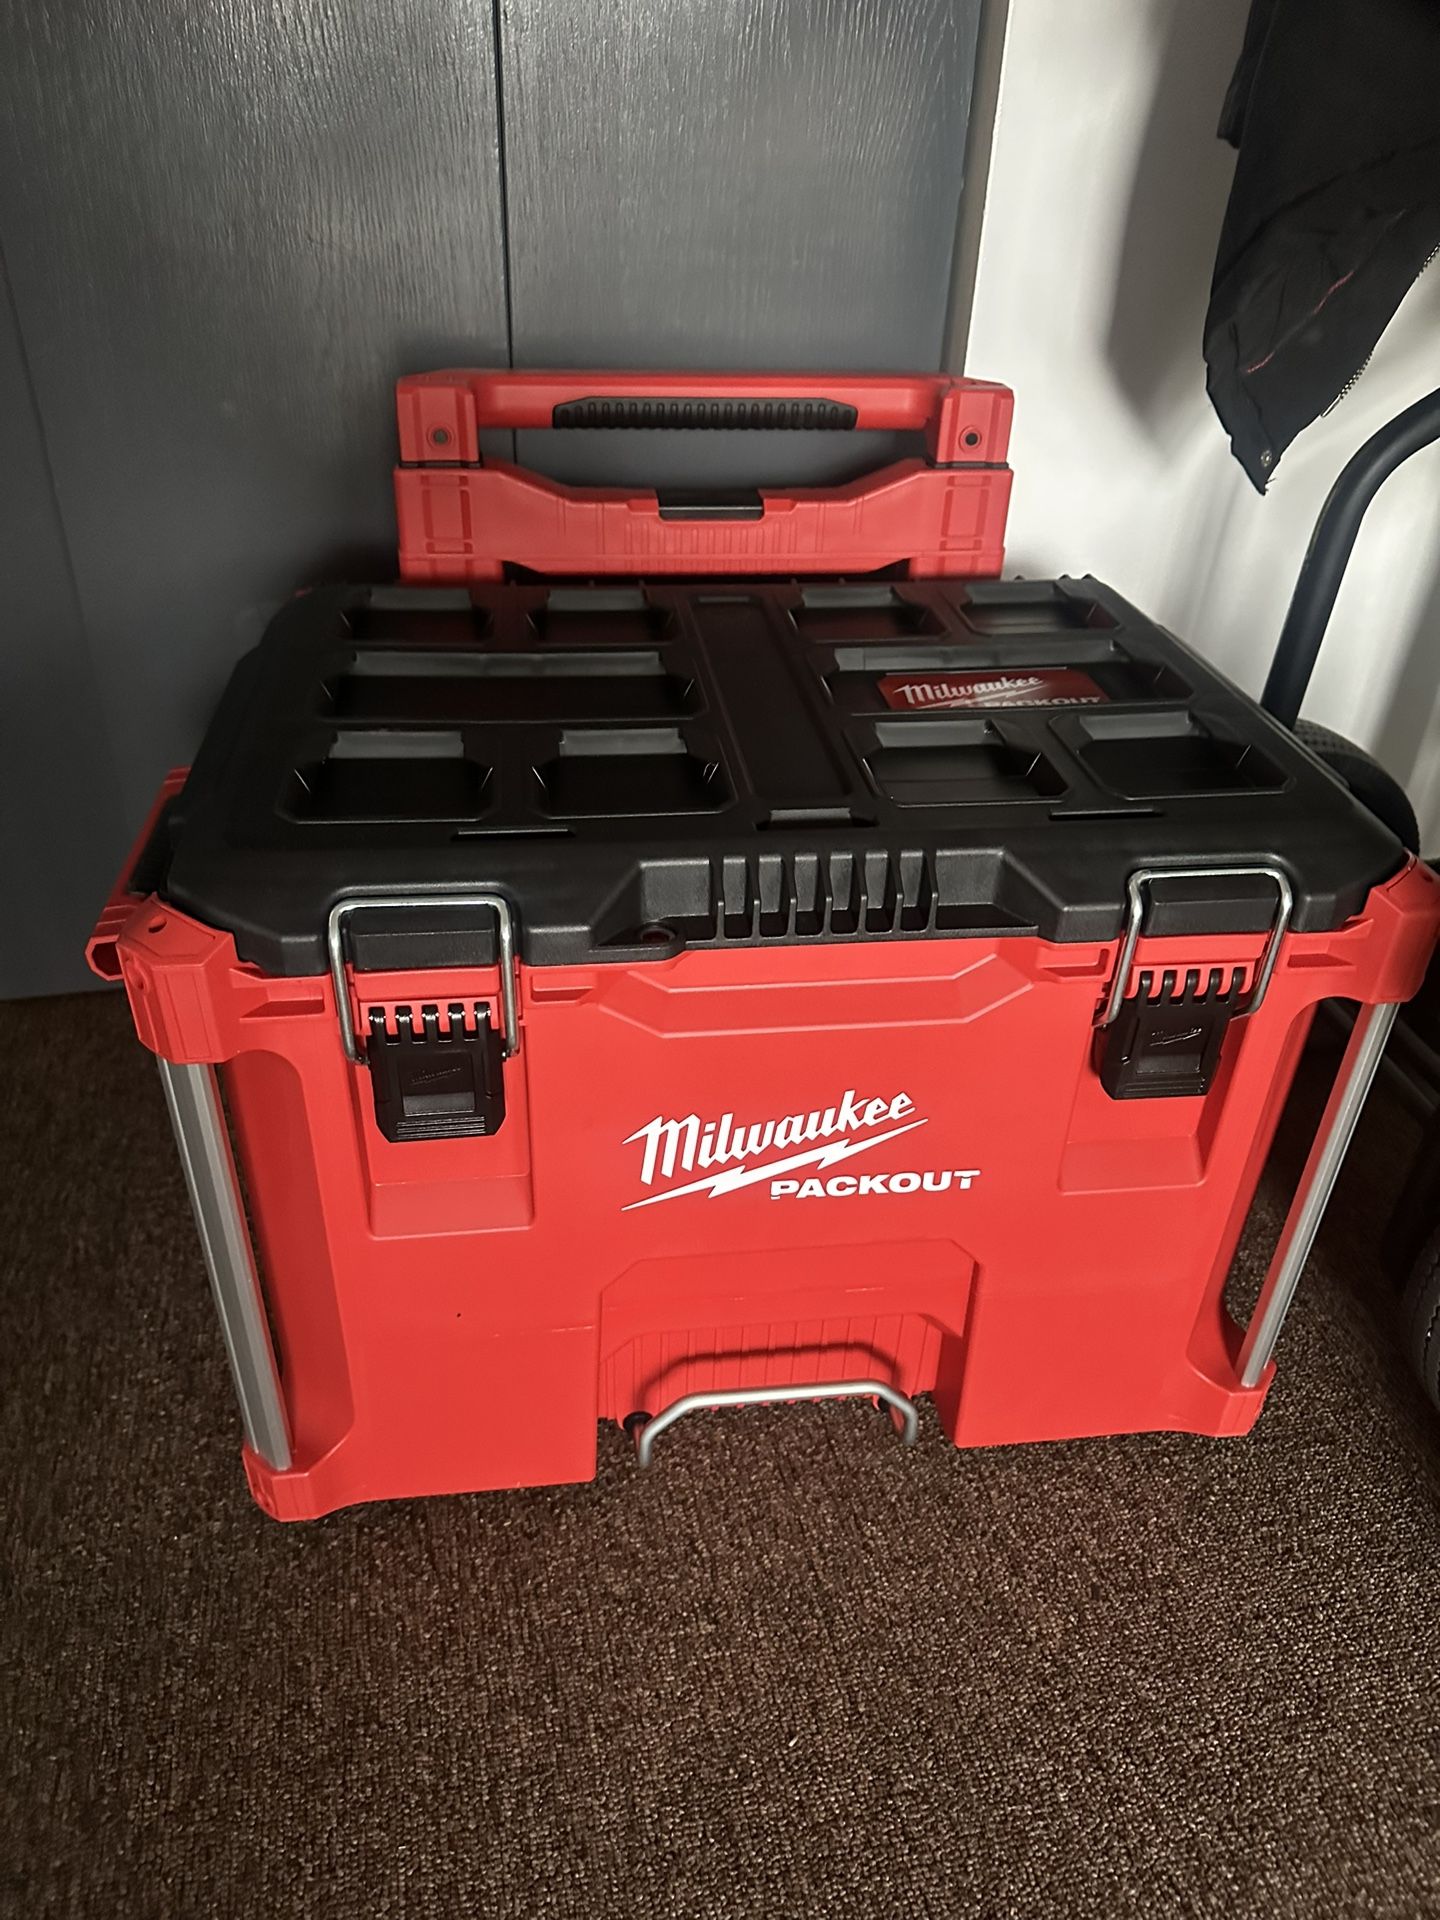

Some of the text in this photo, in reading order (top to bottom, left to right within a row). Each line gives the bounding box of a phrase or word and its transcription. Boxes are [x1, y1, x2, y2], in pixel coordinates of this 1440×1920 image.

[893, 677, 1043, 704] Milwaukee
[622, 1089, 916, 1185] Milwaukee
[770, 1169, 981, 1199] PACKOUT
